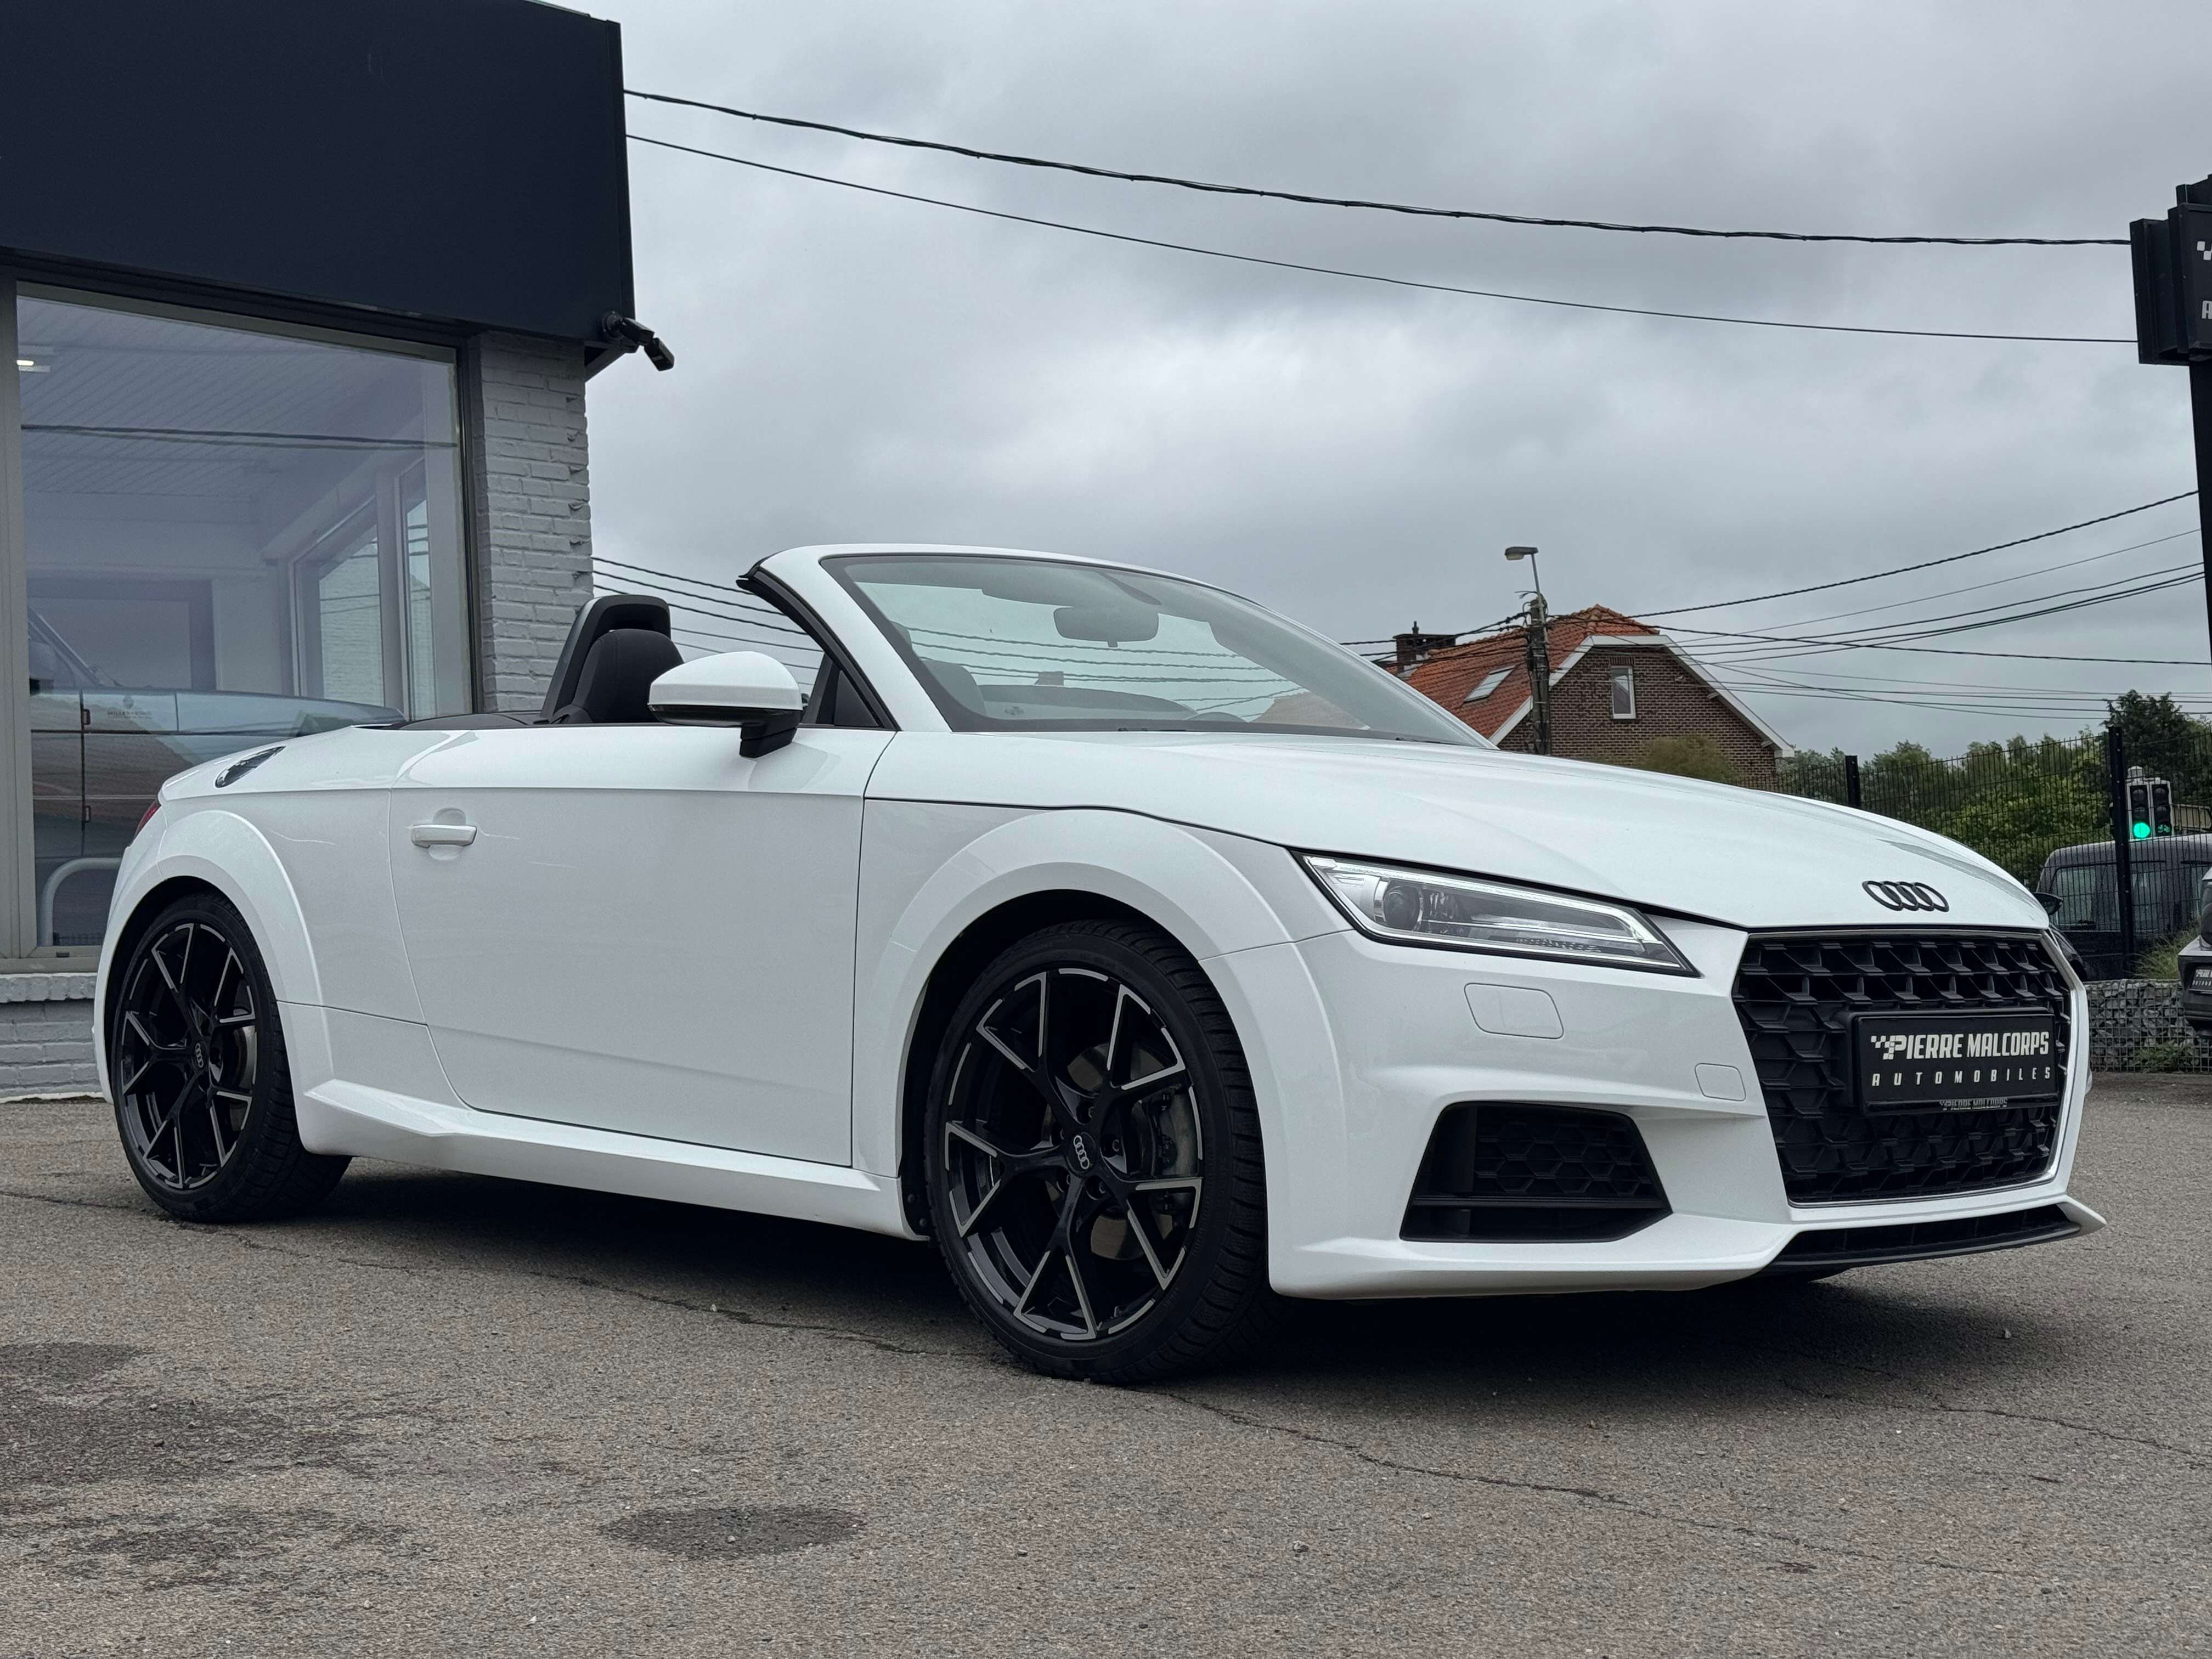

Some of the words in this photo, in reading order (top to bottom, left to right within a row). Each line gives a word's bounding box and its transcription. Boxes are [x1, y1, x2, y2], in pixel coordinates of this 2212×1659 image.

[1882, 1034, 1963, 1060] PIERRE
[1967, 1031, 2049, 1058] MALCORPS
[1872, 1066, 2050, 1087] AUTOMOBILES
